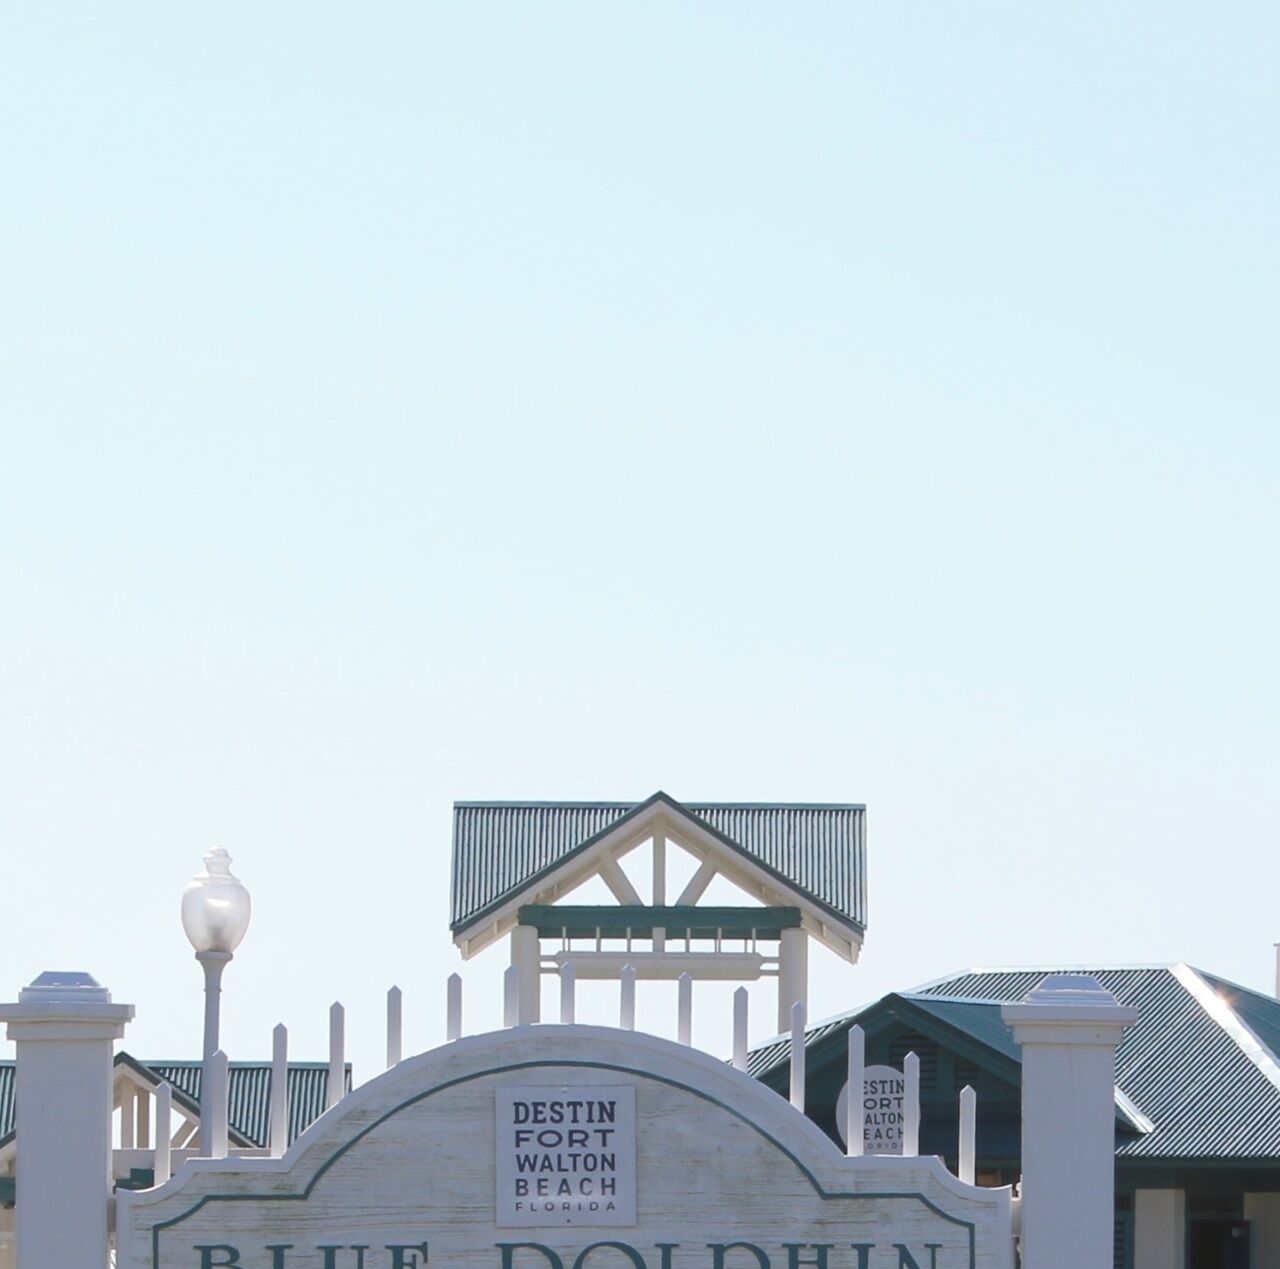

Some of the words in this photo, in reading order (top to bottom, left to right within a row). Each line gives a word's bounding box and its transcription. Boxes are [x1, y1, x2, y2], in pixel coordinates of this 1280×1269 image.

[863, 1080, 904, 1095] ESTIN
[863, 1097, 904, 1110] ORT
[513, 1101, 616, 1124] DESTIN
[864, 1112, 904, 1125] ALTON
[515, 1129, 615, 1148] FORT
[863, 1127, 903, 1140] EACH
[516, 1153, 615, 1173] WALTON
[515, 1177, 615, 1197] BEACH
[515, 1202, 615, 1212] FLORIDA
